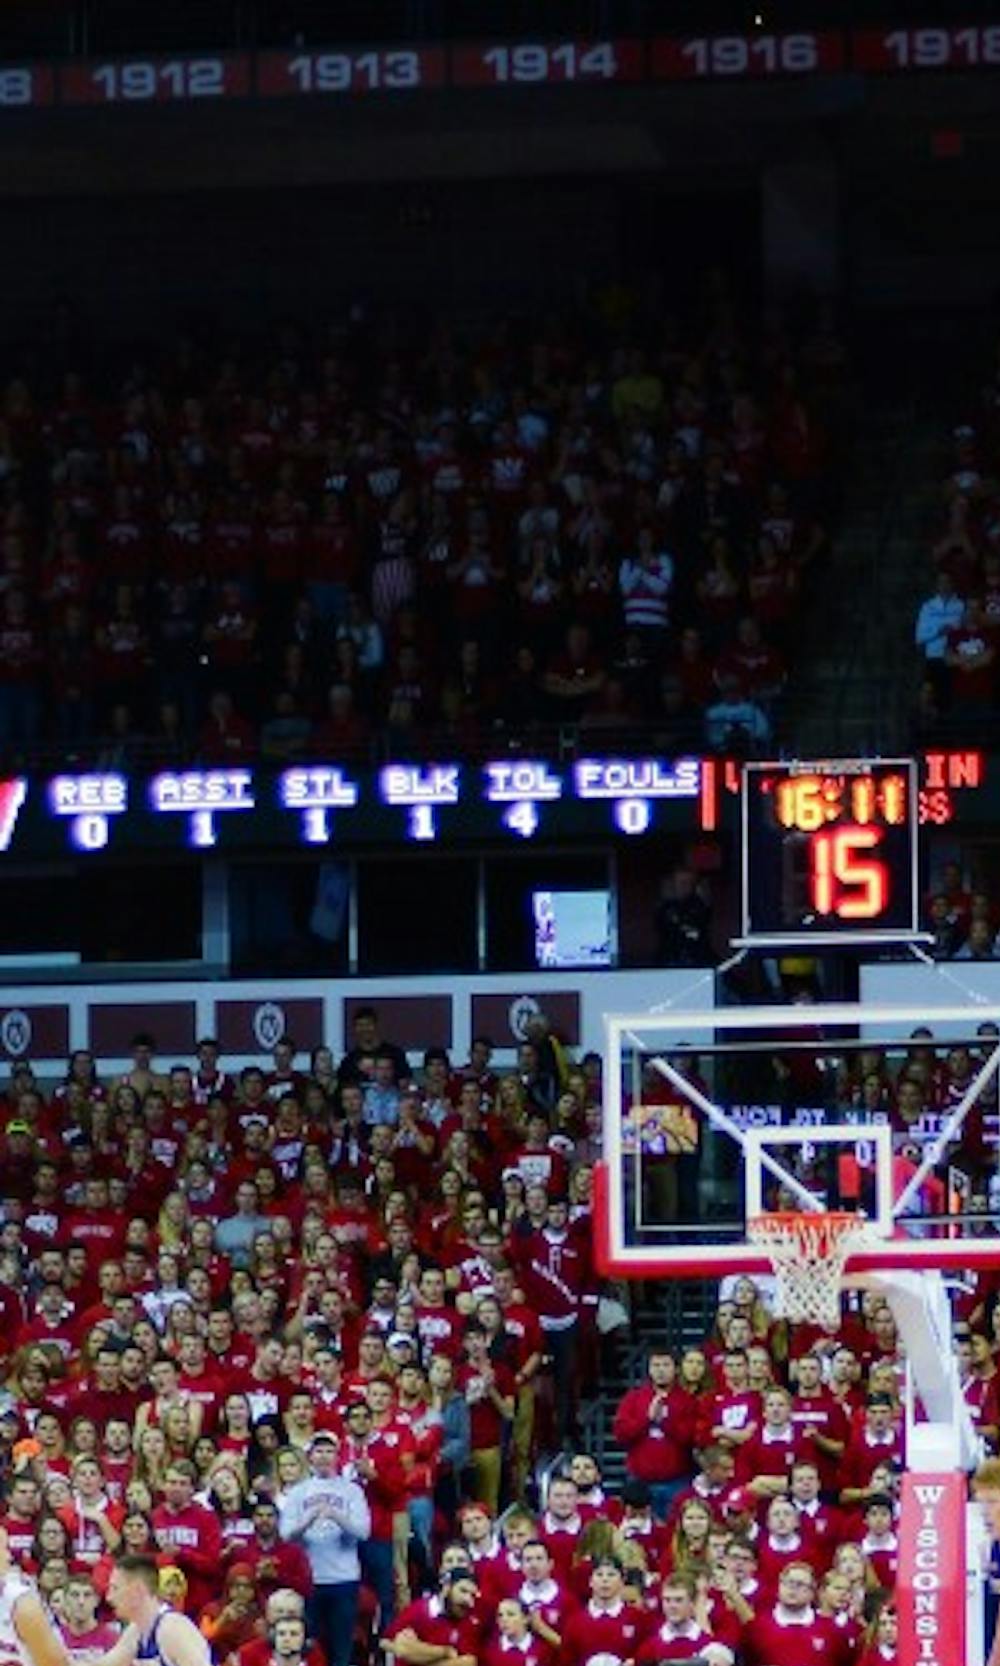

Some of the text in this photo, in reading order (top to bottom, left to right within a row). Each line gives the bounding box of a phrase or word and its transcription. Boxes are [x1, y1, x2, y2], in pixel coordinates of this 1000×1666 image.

[286, 50, 421, 92] 1913
[482, 42, 618, 82] 1914
[681, 33, 819, 76] 1916
[92, 56, 226, 101] 1912
[53, 757, 699, 803] REB ASST STL BLK TOL FOULS
[76, 798, 649, 849] 0 1 1 1 4 0
[774, 774, 906, 832] 16:11
[812, 826, 888, 919] 15
